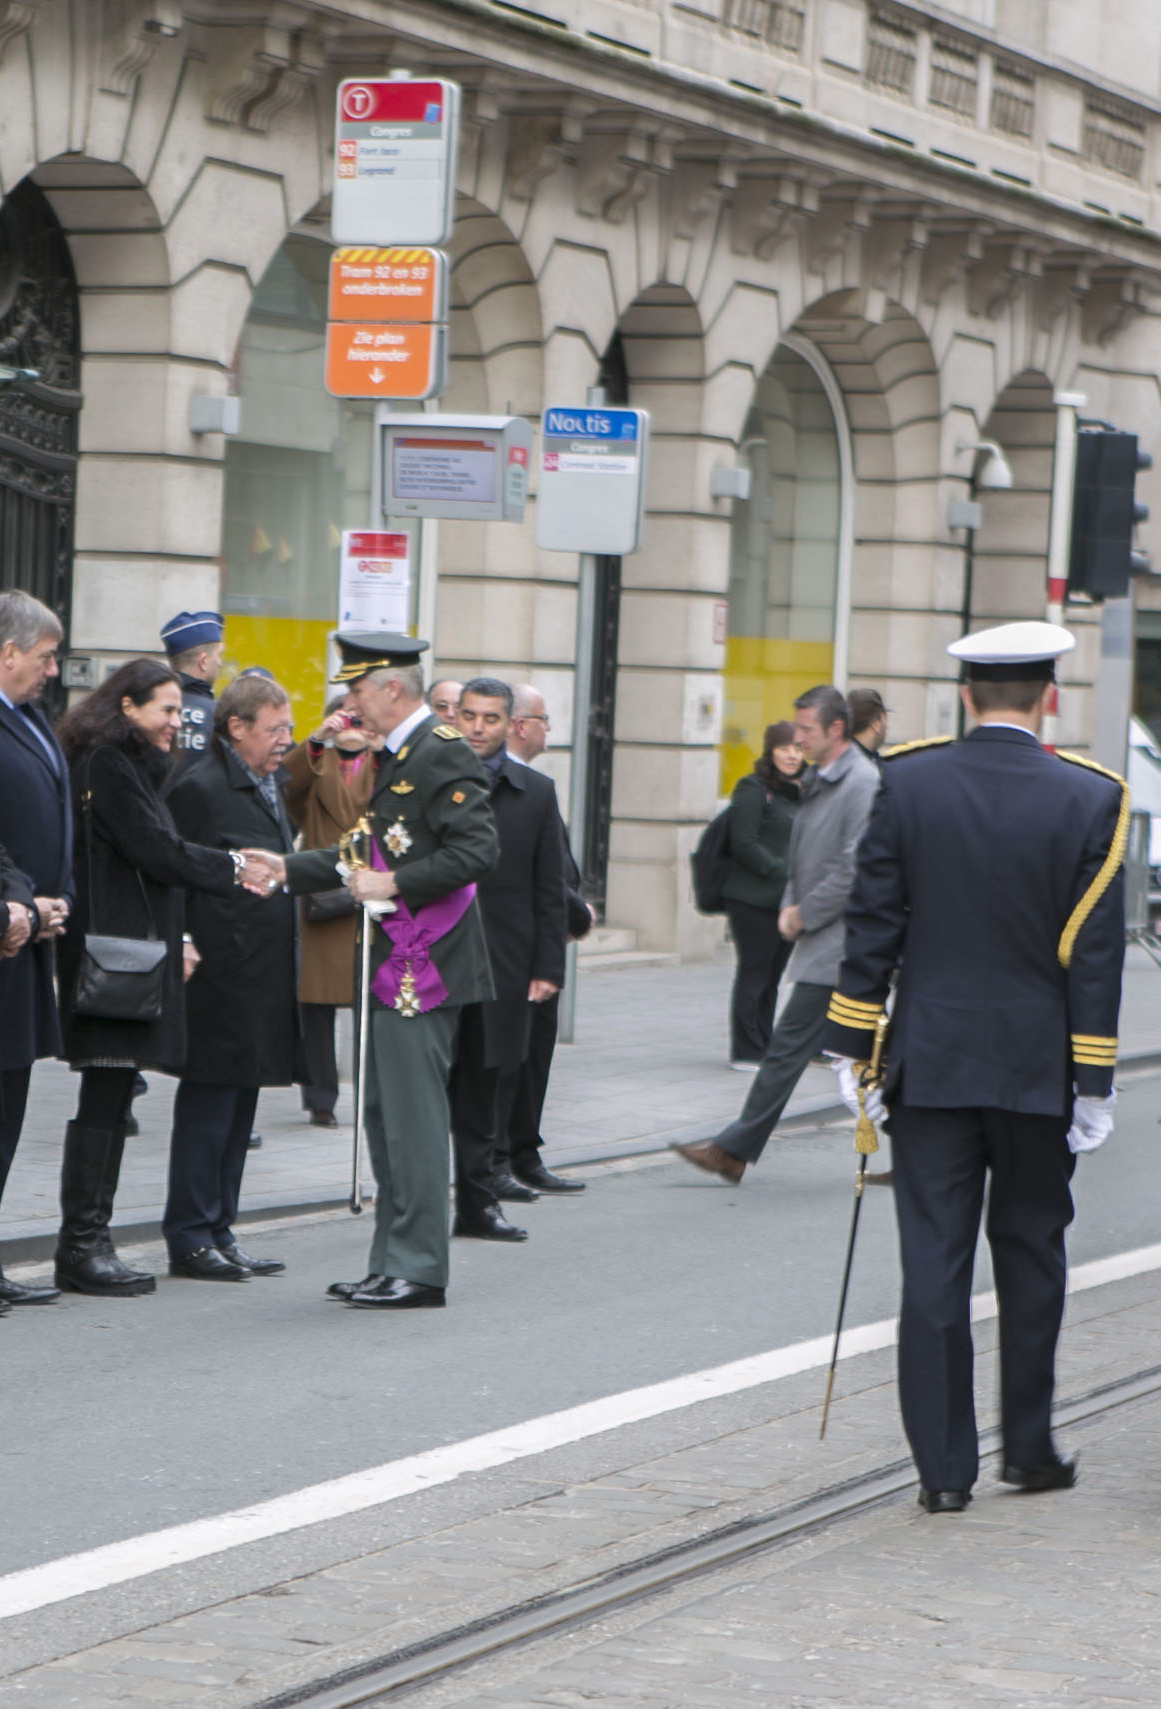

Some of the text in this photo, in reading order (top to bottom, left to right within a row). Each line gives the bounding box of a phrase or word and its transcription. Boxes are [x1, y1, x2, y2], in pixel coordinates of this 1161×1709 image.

[340, 143, 356, 157] 92
[339, 163, 355, 177] 93
[340, 265, 428, 280] Tram 92 en 93
[342, 282, 424, 296] onderbroken
[352, 331, 405, 347] Zie plan
[347, 347, 410, 362] hieronder
